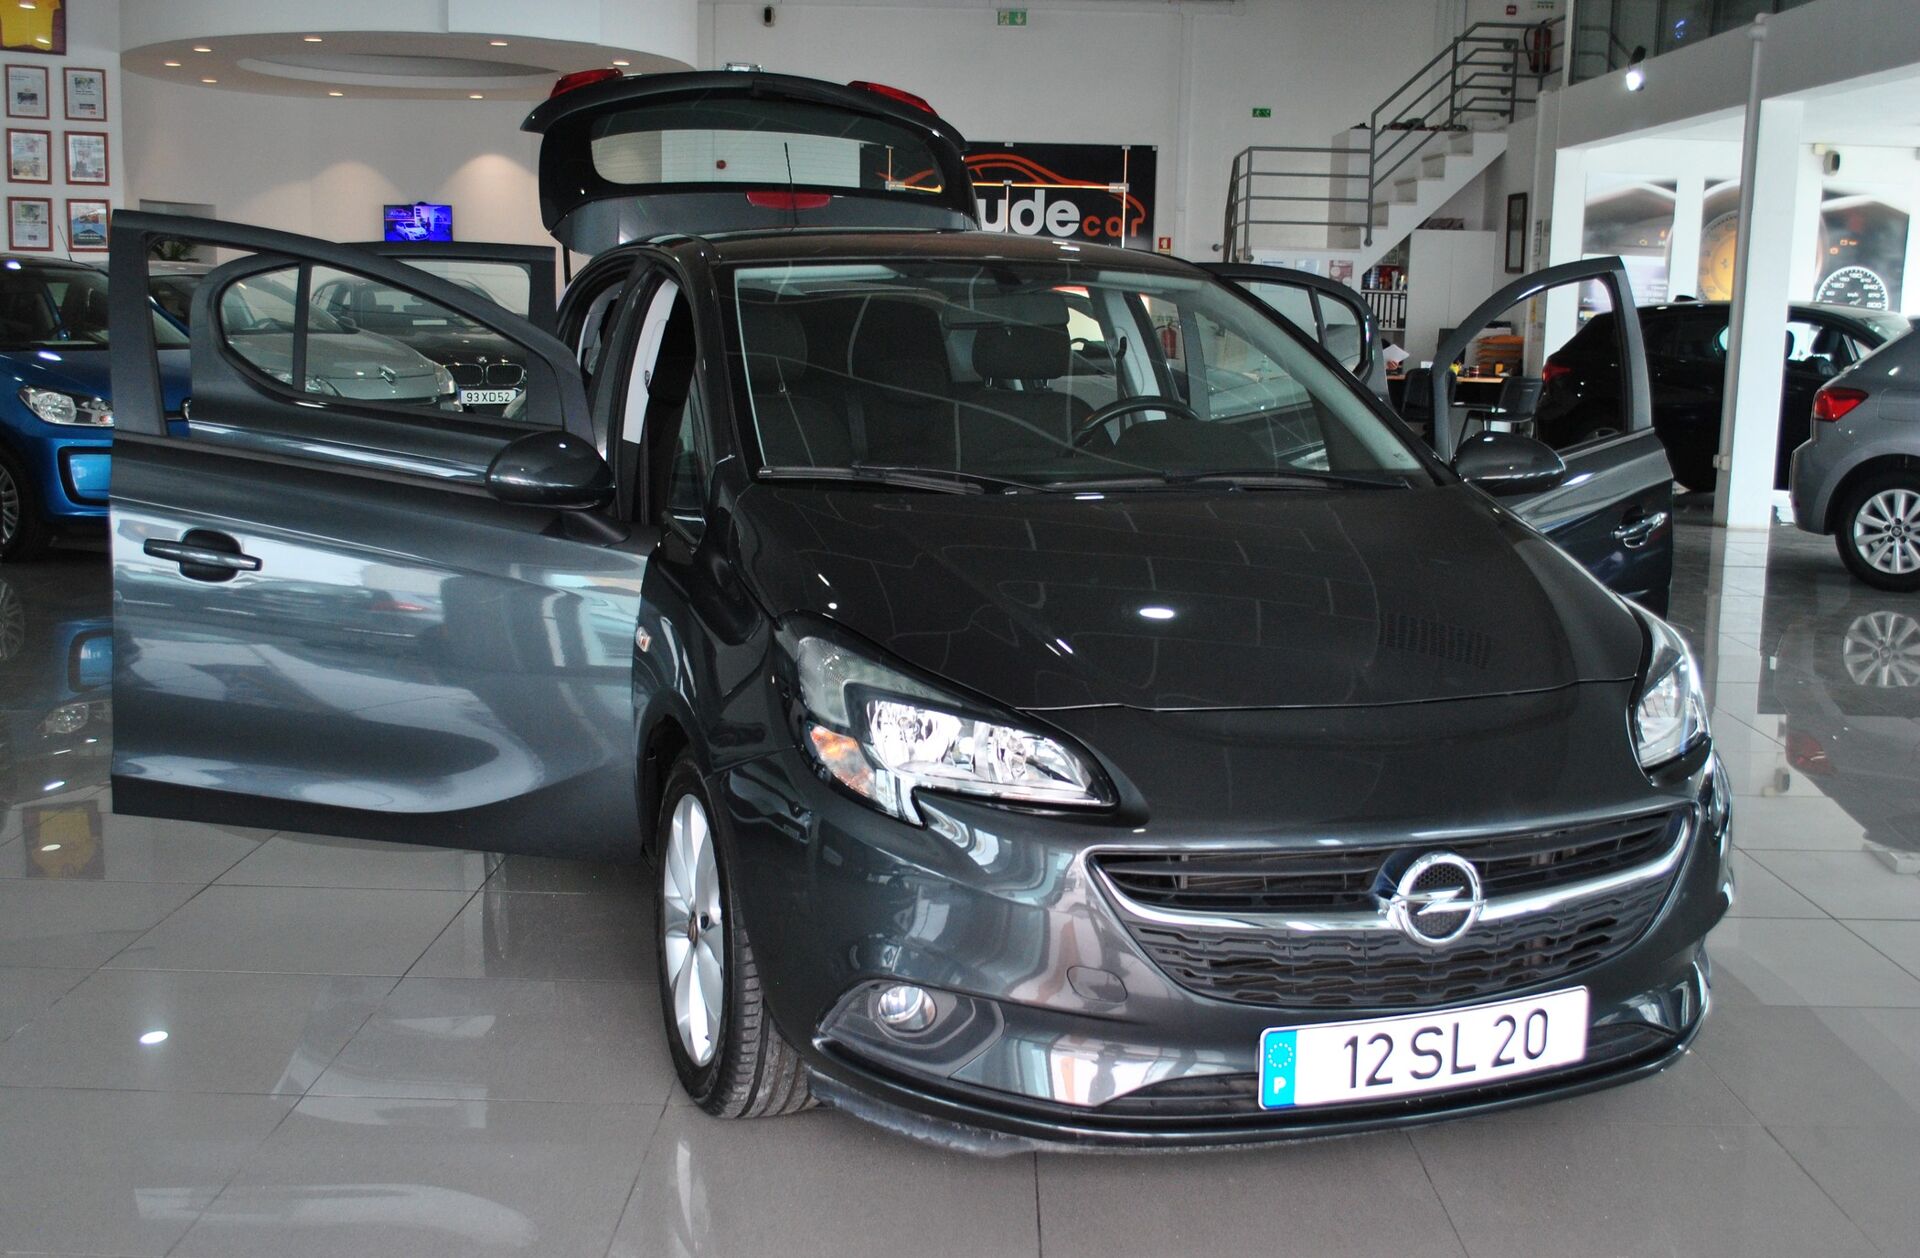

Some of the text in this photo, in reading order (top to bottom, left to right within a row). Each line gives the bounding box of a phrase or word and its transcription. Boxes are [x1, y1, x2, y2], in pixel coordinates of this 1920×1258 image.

[1343, 1008, 1548, 1089] 12 SL 20
[1273, 1076, 1286, 1094] P
